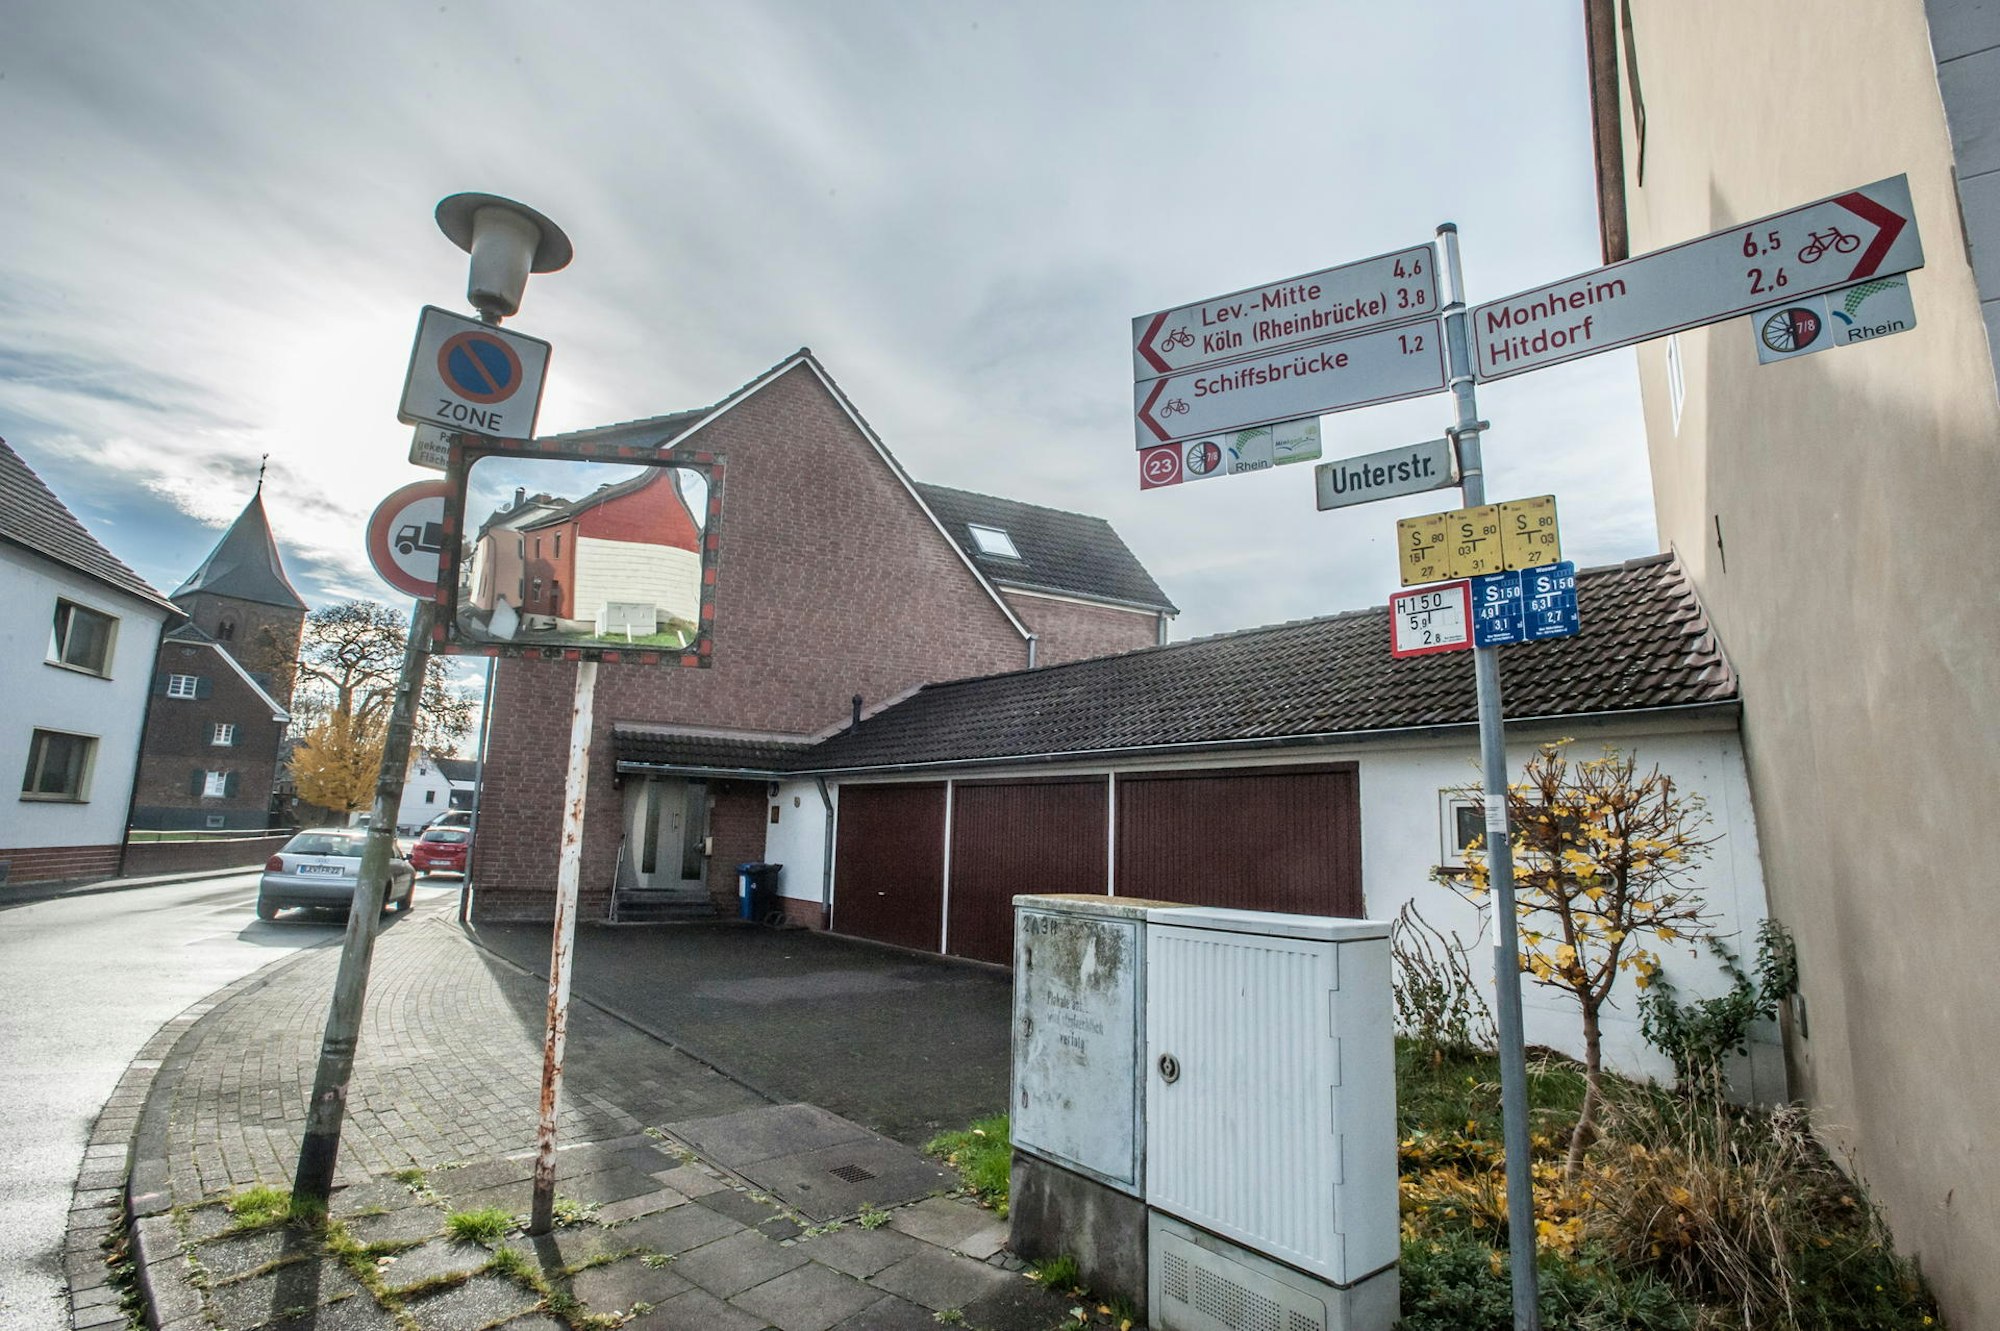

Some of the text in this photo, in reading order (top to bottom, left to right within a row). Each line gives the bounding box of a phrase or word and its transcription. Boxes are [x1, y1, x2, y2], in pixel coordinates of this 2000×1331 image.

[1743, 230, 1781, 258] 6,5
[1393, 258, 1422, 279] 4,6
[1747, 267, 1788, 295] 2,6
[1202, 284, 1321, 327] Lev.-Mitte
[1397, 288, 1425, 309] 3,8
[1487, 275, 1626, 334] Monheim
[1203, 292, 1387, 354] Köln (Rheinbrücke)
[1848, 320, 1905, 342] Rhein
[1398, 334, 1424, 355] 1,2
[1489, 316, 1594, 366] Hitdorf
[1194, 352, 1349, 398] Schiffsbrücke
[436, 399, 503, 432] ZONE
[1150, 458, 1172, 475] 23
[1235, 460, 1268, 472] Rhein
[1332, 455, 1435, 495] Unterstr.
[1461, 523, 1497, 538] S 80
[1517, 514, 1553, 530] S 80
[1412, 531, 1444, 546] S 80
